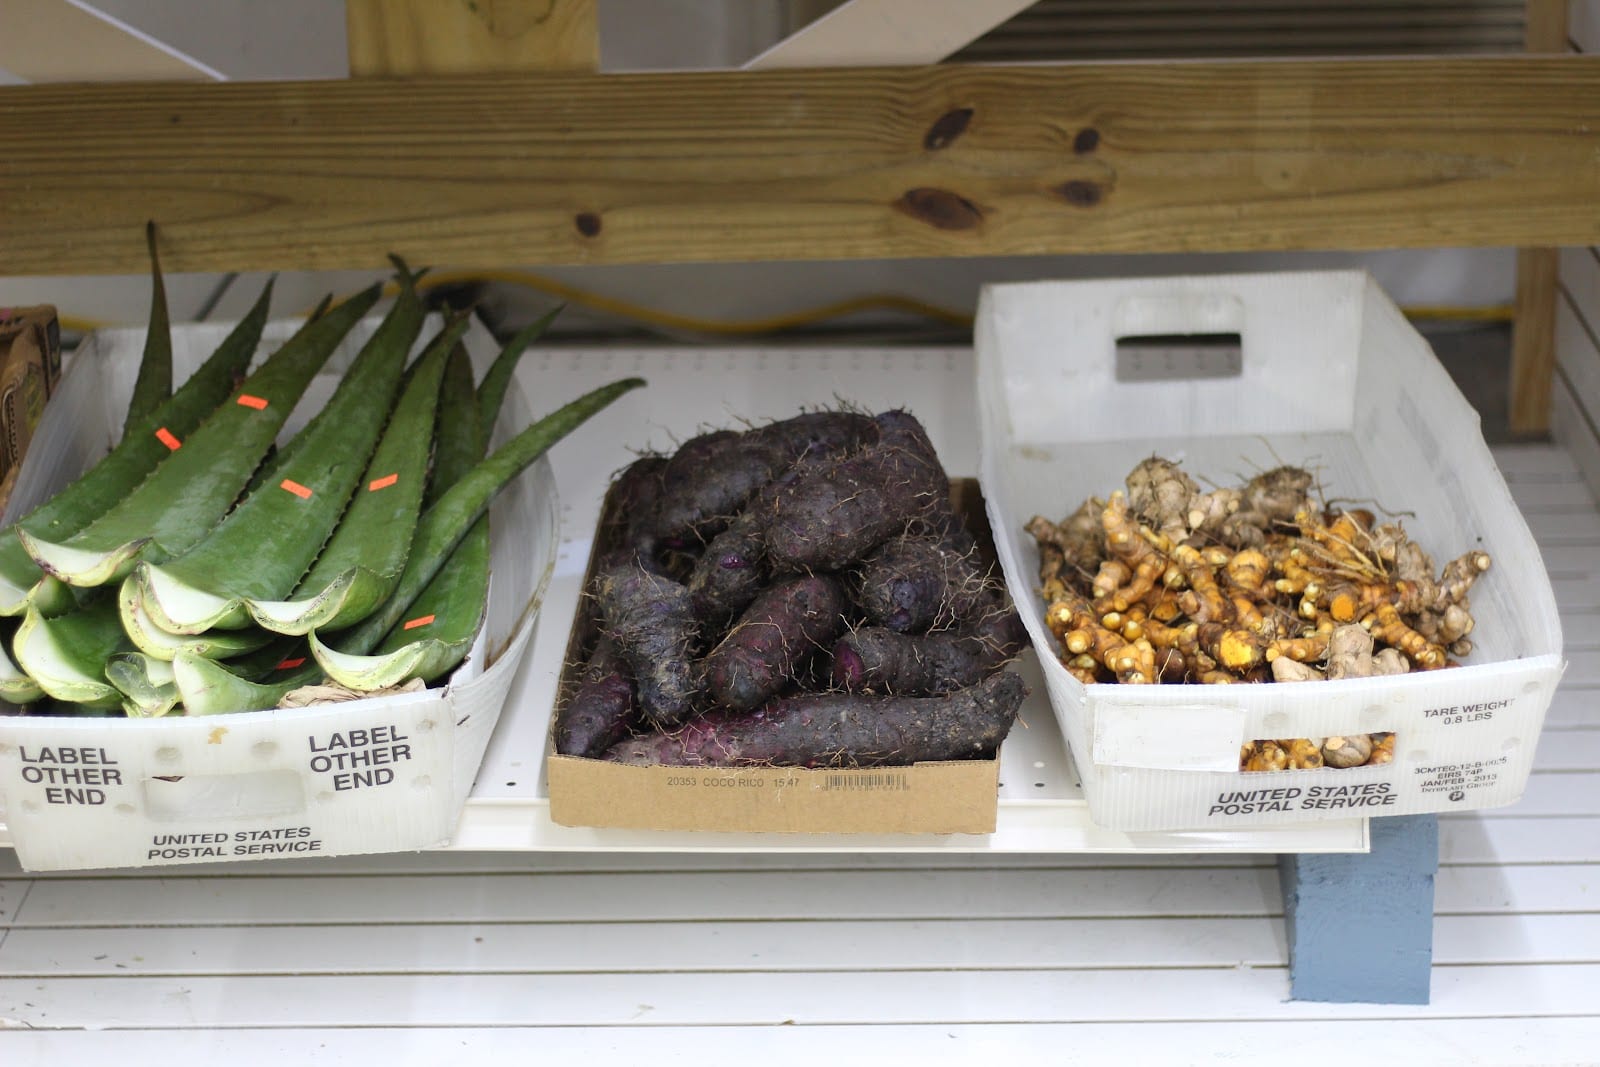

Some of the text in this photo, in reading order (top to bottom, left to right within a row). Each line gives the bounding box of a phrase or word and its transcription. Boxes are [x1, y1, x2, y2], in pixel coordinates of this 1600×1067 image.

[1424, 698, 1516, 718] TARE WEIGHT
[1443, 711, 1493, 725] 0.8 LBS
[309, 725, 408, 752] LABEL
[19, 746, 118, 765] LABEL
[310, 744, 411, 773] OTHER
[22, 766, 122, 785] OTHER
[334, 768, 395, 791] END
[667, 777, 697, 786] 20353
[703, 778, 735, 787] COCO
[738, 778, 764, 787] RICO
[1420, 777, 1465, 787] JAN/FEB
[45, 787, 106, 805] END
[1218, 782, 1391, 804] UNITED STATES
[1208, 794, 1398, 816] POSTAL SERVICE
[153, 827, 311, 846] UNITED STATES
[148, 840, 322, 860] POSTAL SERVICE
